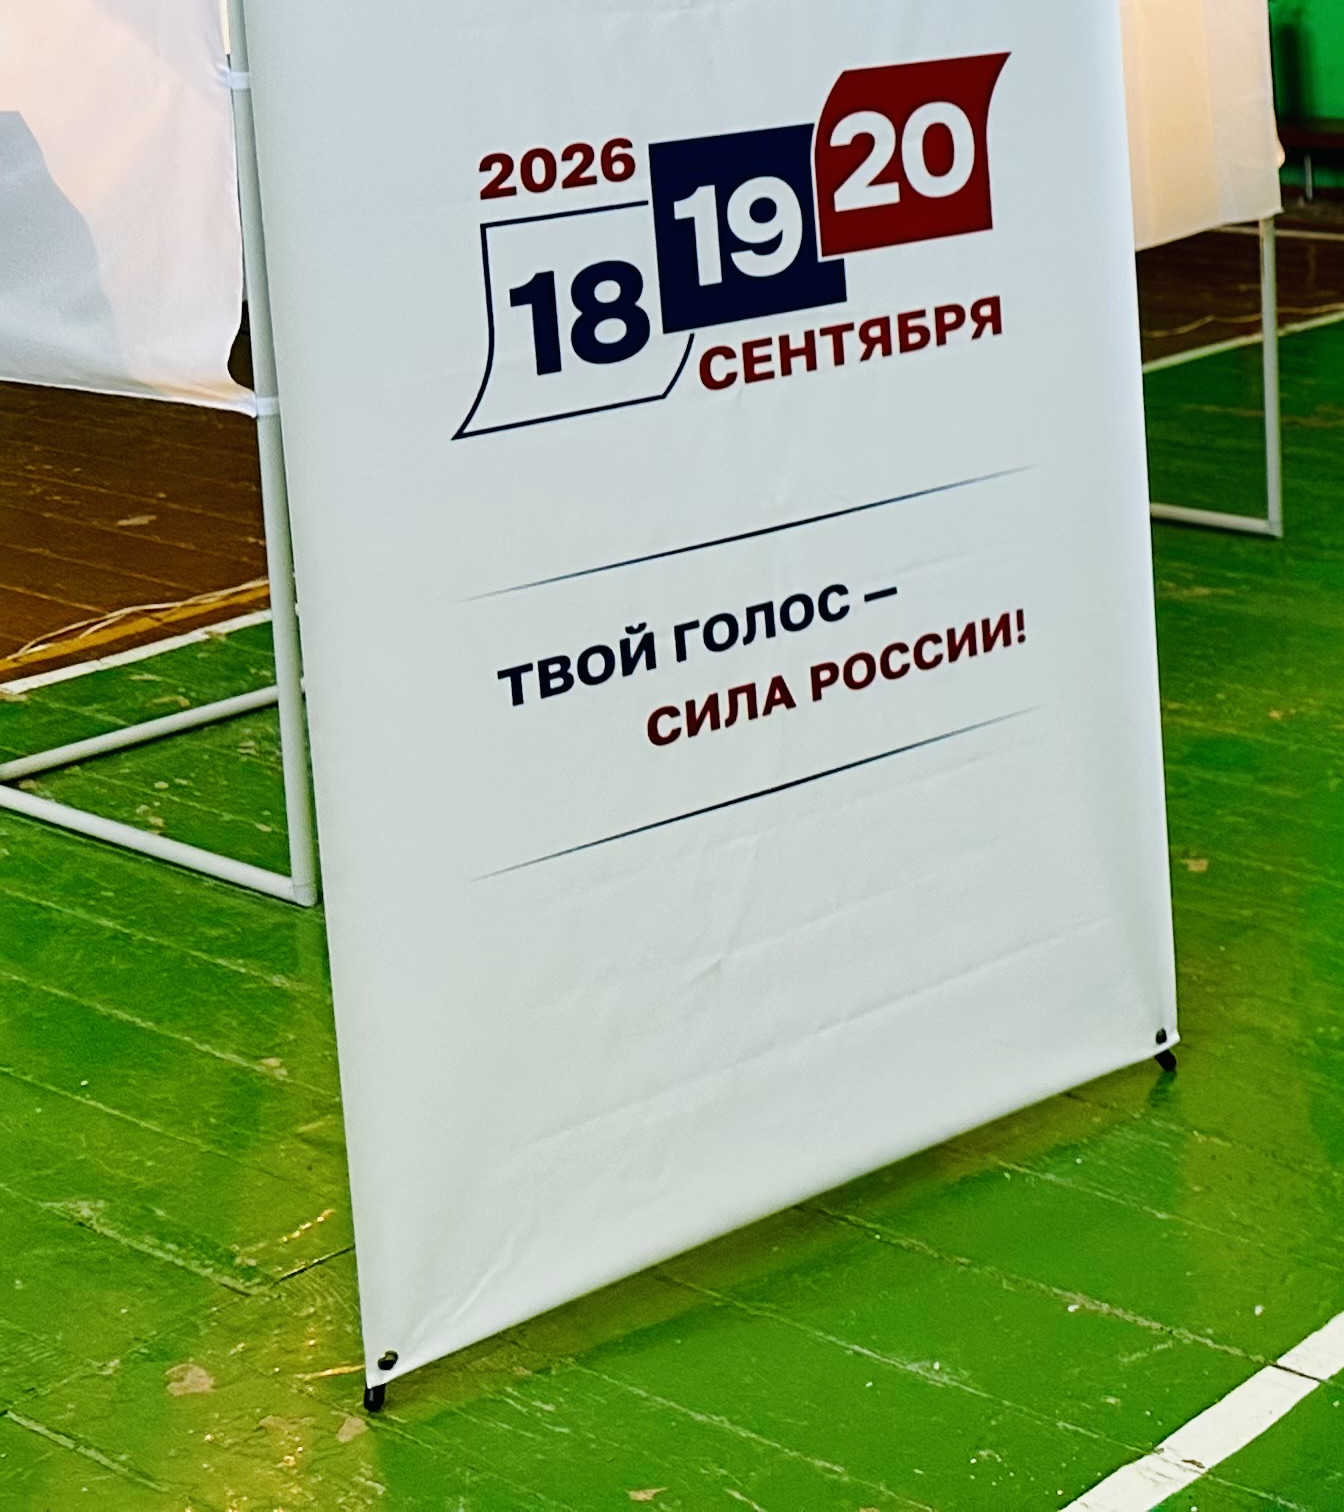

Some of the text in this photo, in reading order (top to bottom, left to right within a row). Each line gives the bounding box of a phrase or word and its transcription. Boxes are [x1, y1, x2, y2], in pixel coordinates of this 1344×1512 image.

[478, 137, 636, 201] 2026
[828, 101, 974, 211] 20
[673, 176, 802, 286] 19
[508, 260, 651, 376] 18
[699, 295, 1002, 391] СЕНТЯБРЯ
[497, 622, 657, 707] ТВОЙ
[673, 583, 850, 663] ГОЛОС
[647, 609, 1026, 747] СИЛА РОССИИ!
